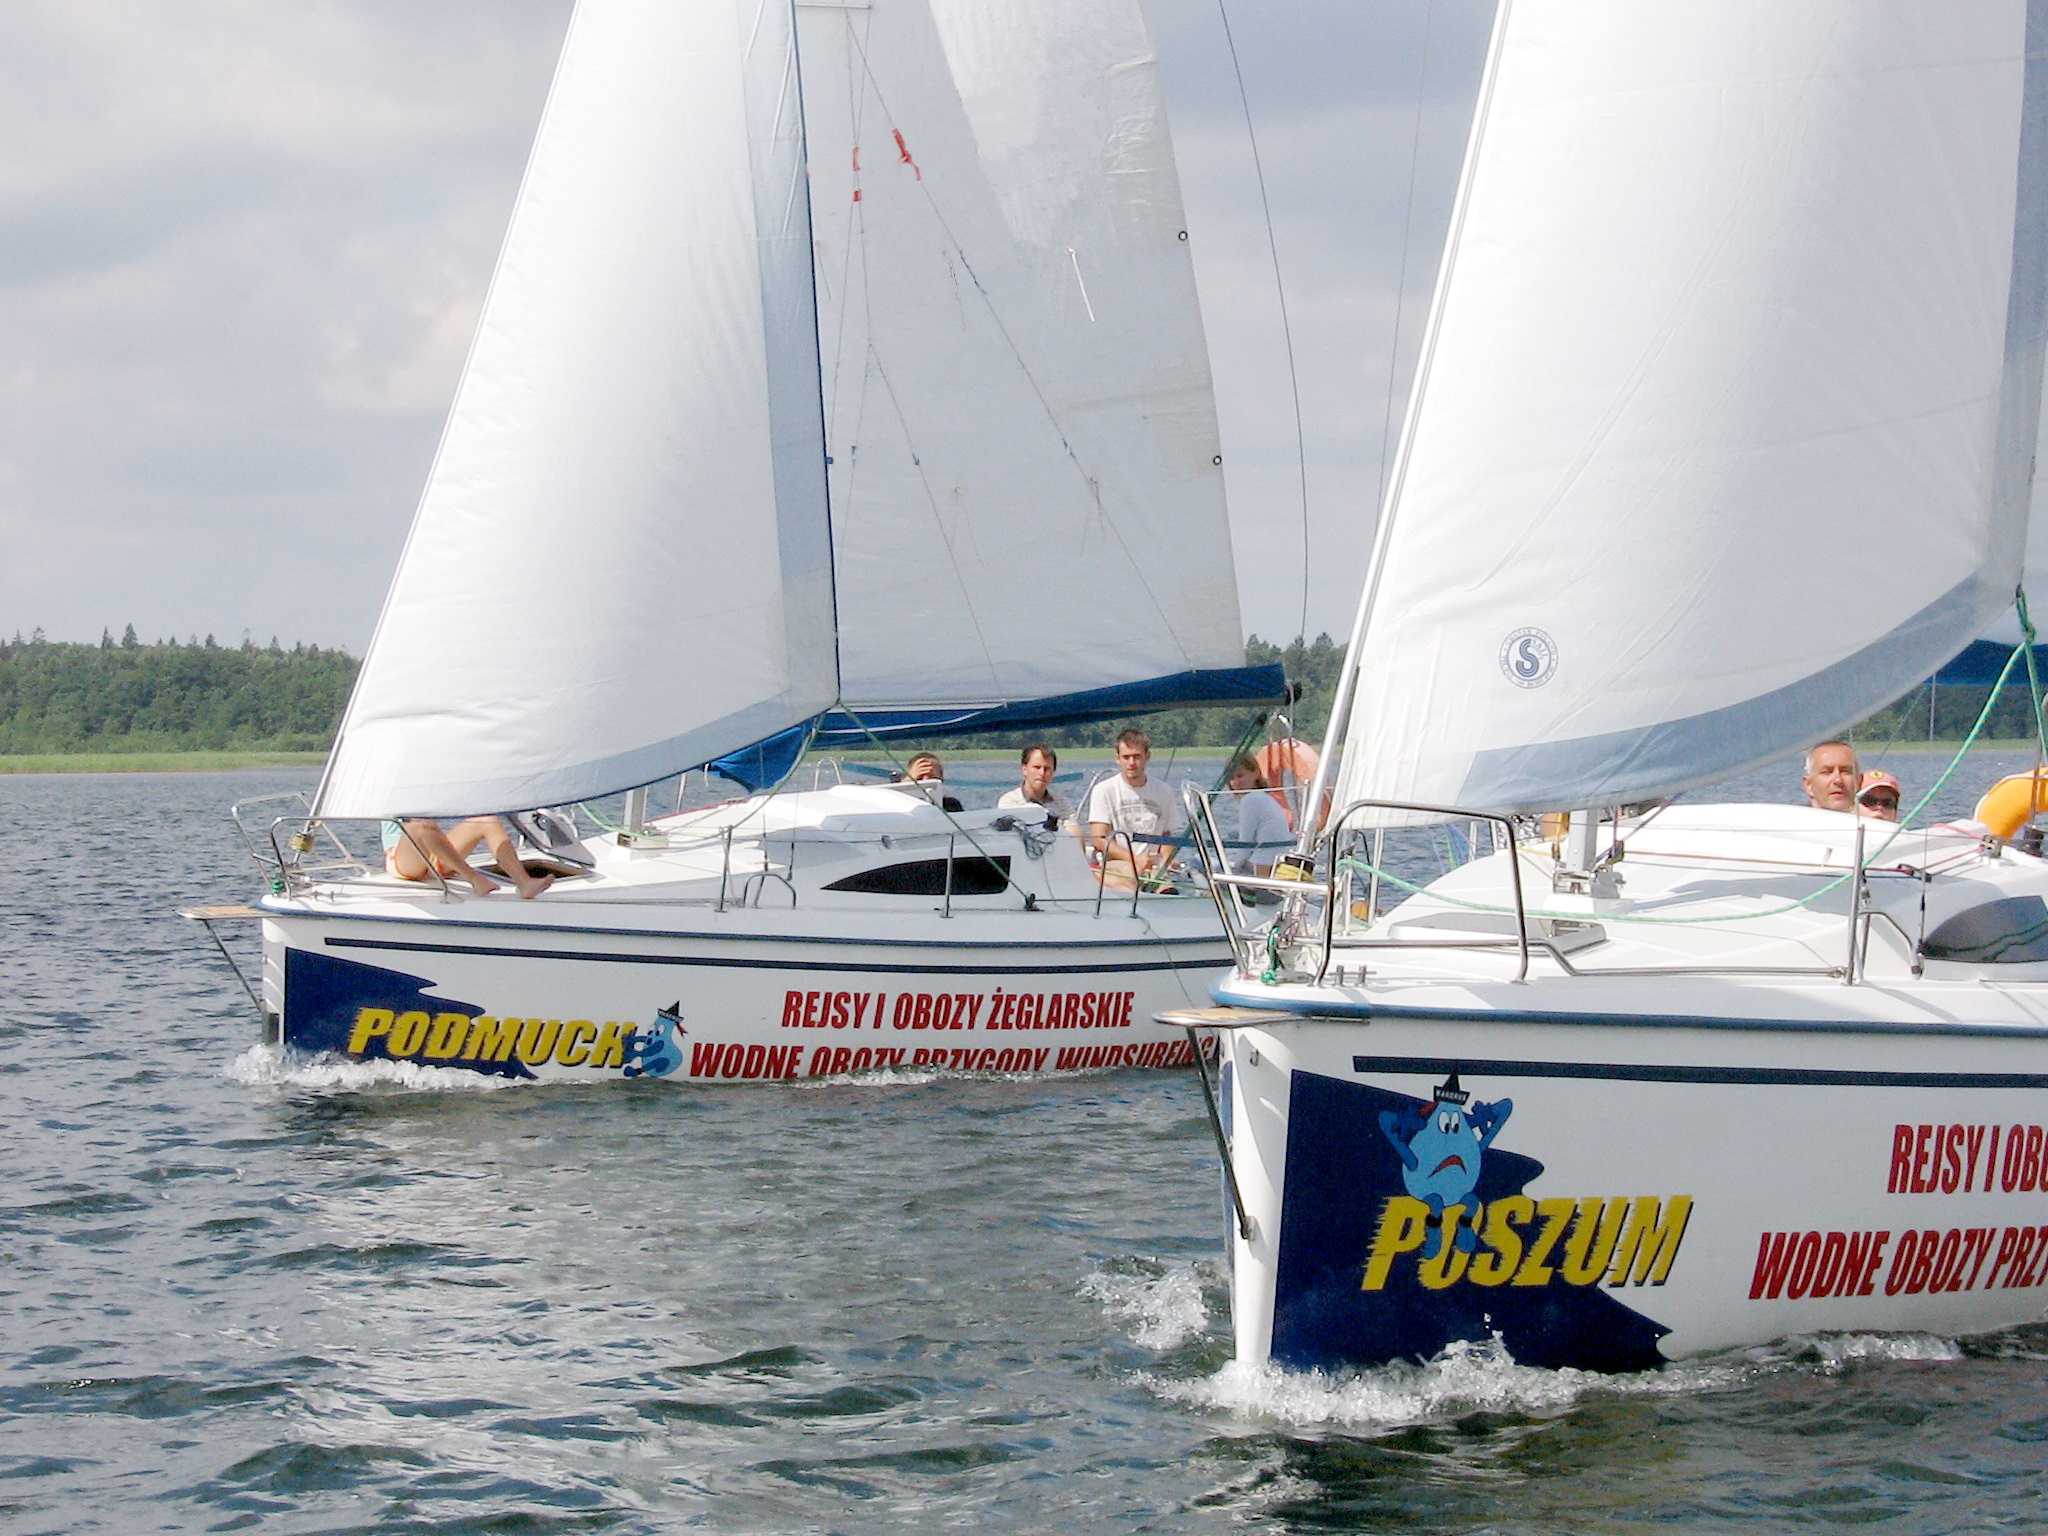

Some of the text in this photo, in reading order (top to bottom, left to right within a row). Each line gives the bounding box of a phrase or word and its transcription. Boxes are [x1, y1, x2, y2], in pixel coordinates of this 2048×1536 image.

[346, 1007, 638, 1069] PODMUCH
[782, 986, 1135, 1031] REJSY I OBOZY ŻEGLARSKIE
[690, 1042, 804, 1079] WODNE
[1886, 1124, 1985, 1194] REJSY
[1983, 1125, 2001, 1192] I
[1360, 1194, 1694, 1291] POSZUM
[1748, 1230, 1890, 1300] WODNE
[1884, 1227, 1997, 1297] OBOZY
